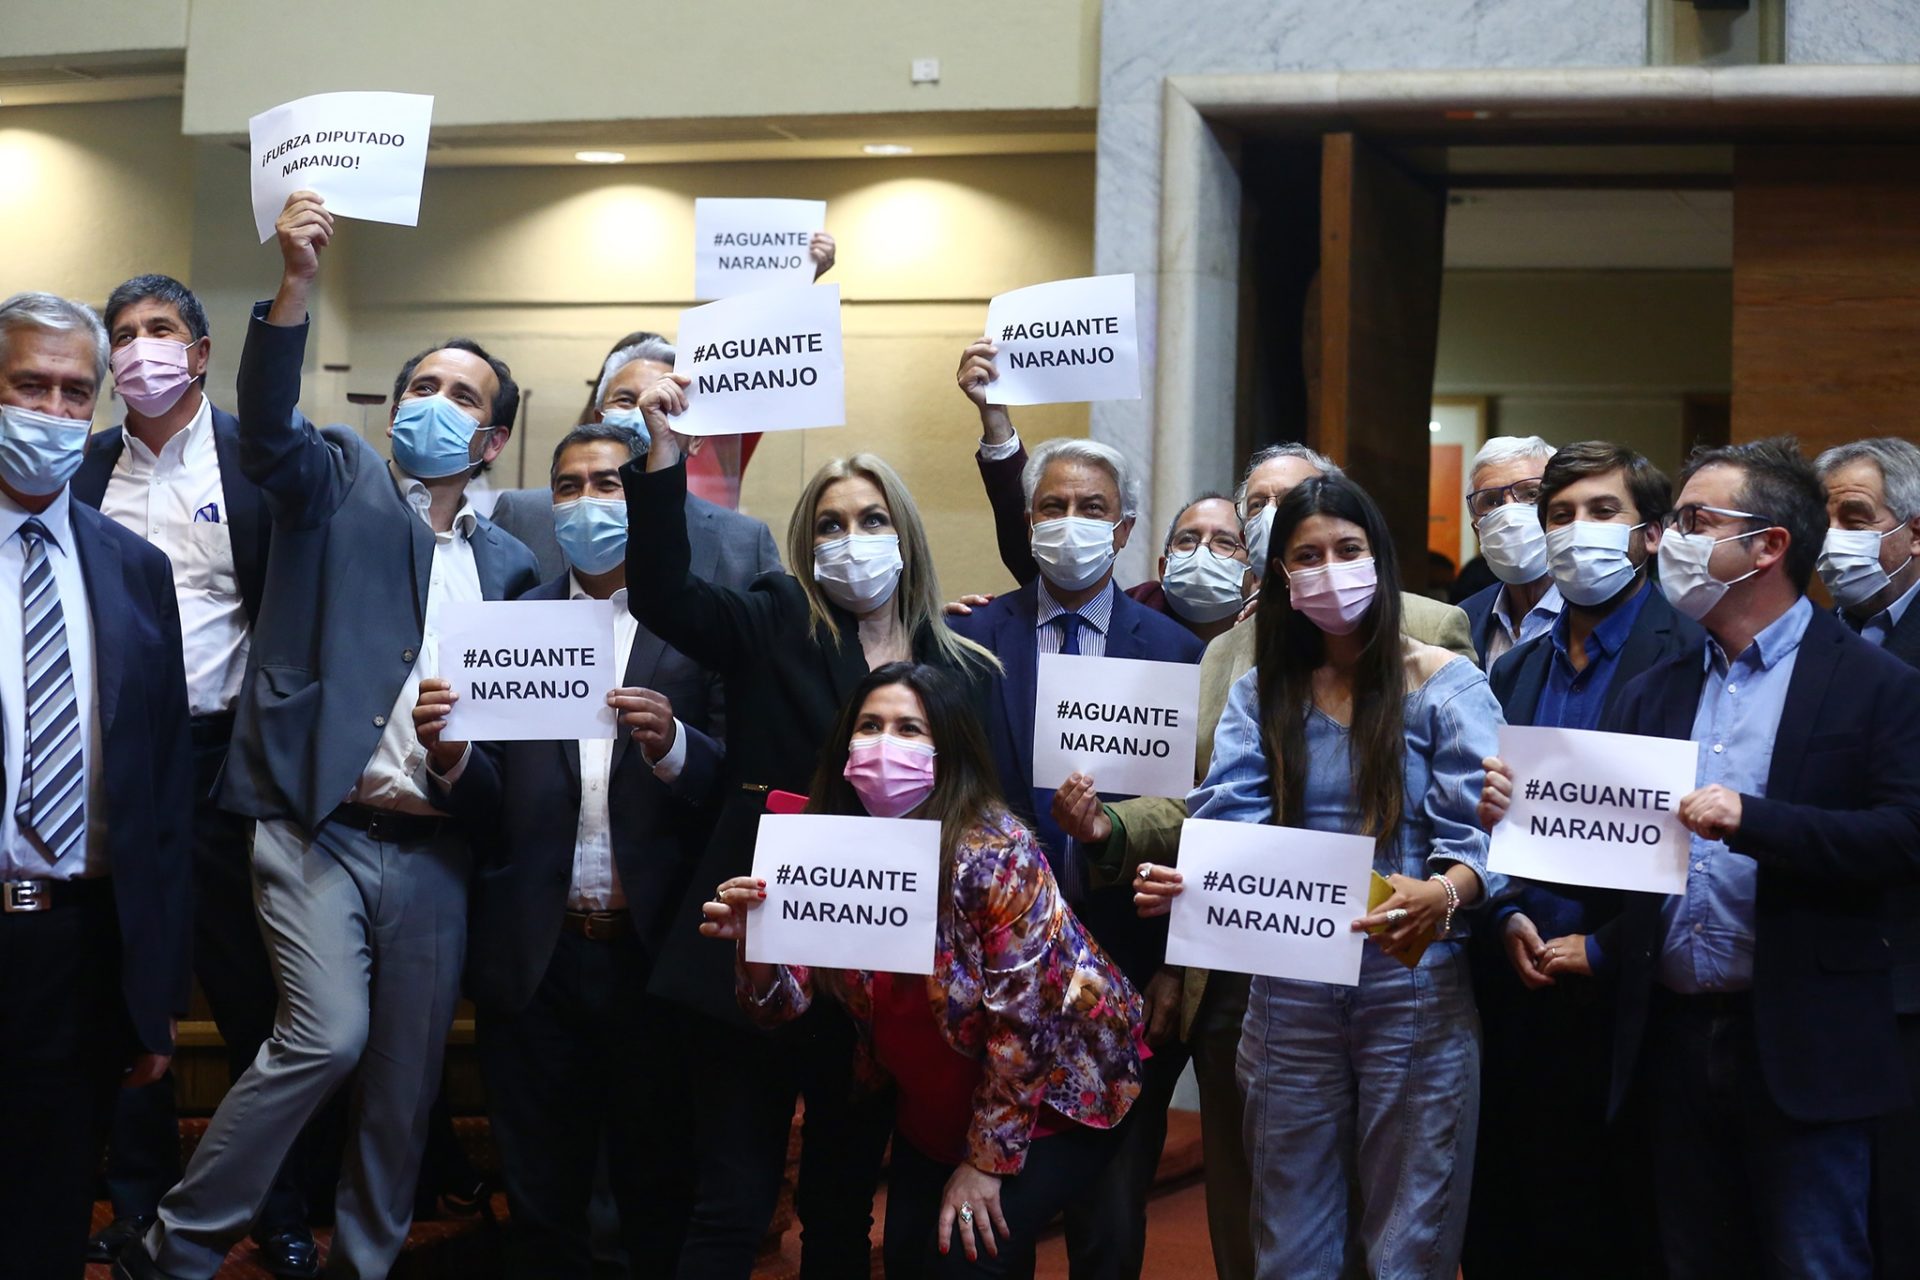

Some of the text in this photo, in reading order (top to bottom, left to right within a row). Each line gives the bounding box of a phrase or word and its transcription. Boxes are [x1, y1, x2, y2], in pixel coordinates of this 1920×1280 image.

[262, 131, 405, 169] ¡FUERZA DIPUTADO
[283, 155, 360, 178] NARANJO!
[713, 232, 808, 247] #AGUANTE
[718, 255, 802, 270] NARANJO
[1002, 317, 1119, 342] #AGUANTE
[694, 333, 823, 364] #AGUANTE
[1010, 347, 1115, 370] NARANJO
[699, 367, 818, 395] NARANJO
[464, 648, 596, 669] #AGUANTE
[472, 680, 590, 700] NARANJO
[1058, 701, 1179, 728] #AGUANTE
[1061, 732, 1171, 759] NARANJO
[1525, 779, 1671, 812] #AGUANTE
[1531, 816, 1662, 846] NARANJO
[777, 865, 918, 893] #AGUANTE
[1204, 871, 1348, 905] #AGUANTE
[783, 900, 909, 928] NARANJO
[1207, 906, 1336, 939] NARANJO
